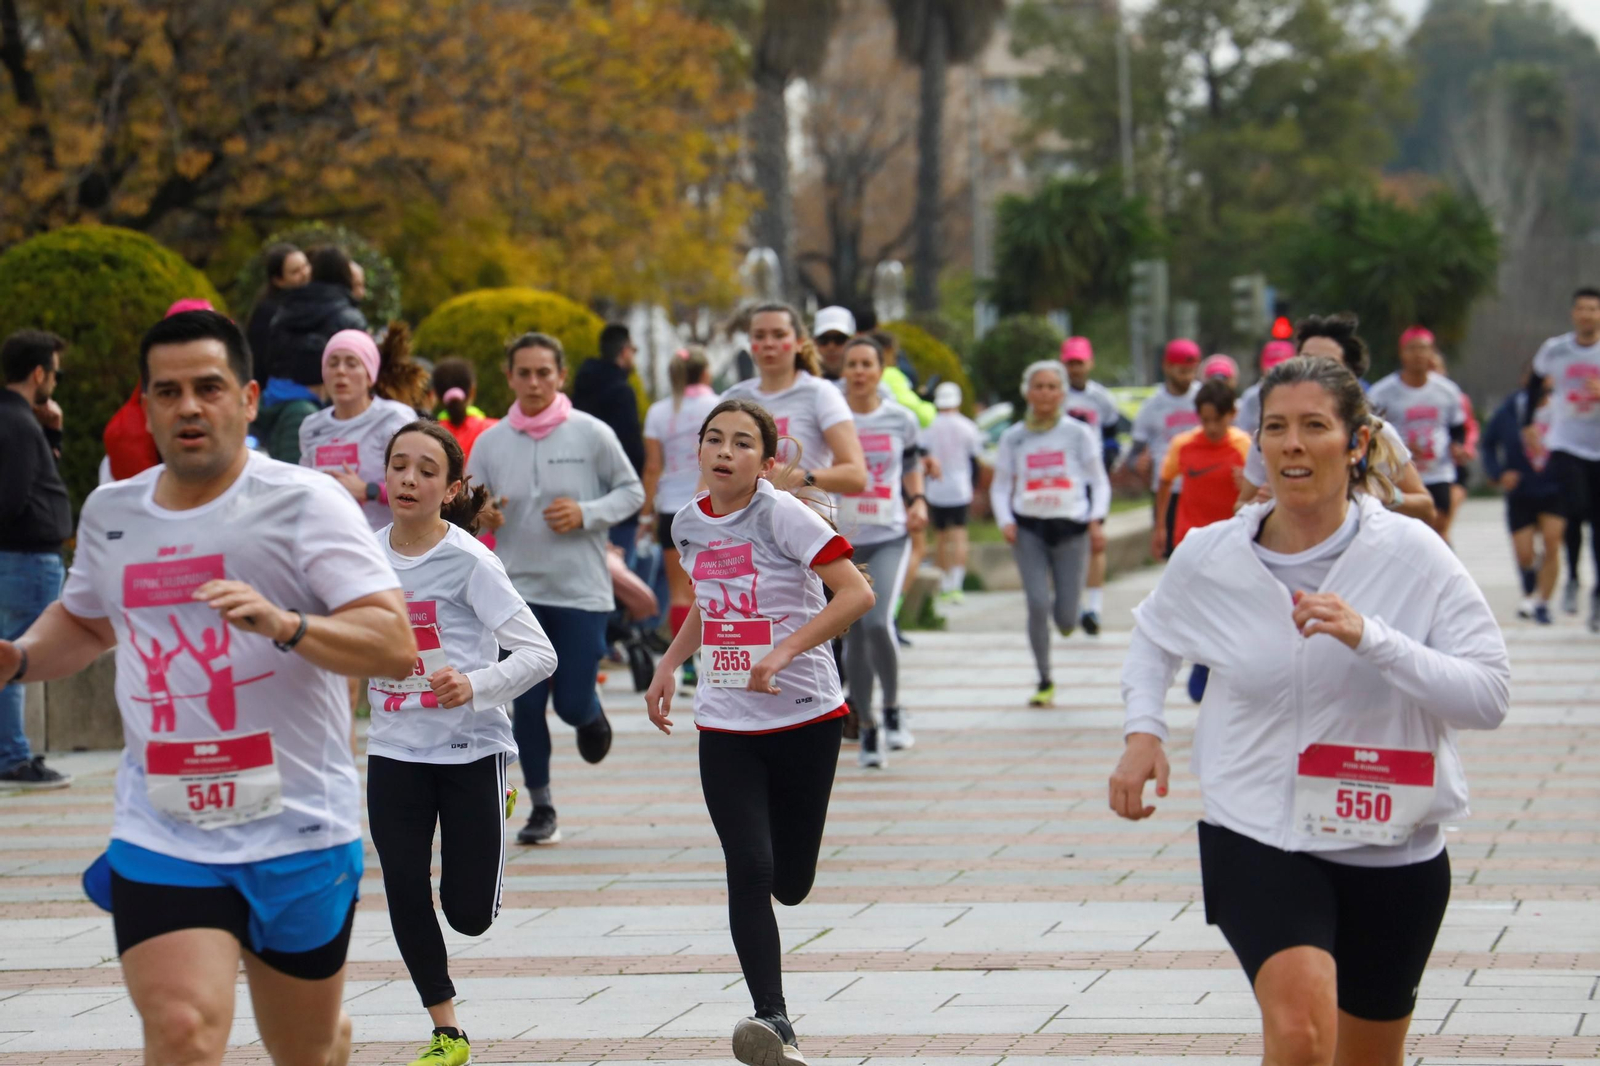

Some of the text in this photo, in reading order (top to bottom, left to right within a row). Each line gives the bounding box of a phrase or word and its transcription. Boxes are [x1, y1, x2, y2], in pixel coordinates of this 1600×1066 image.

[700, 561, 718, 569] PINK
[712, 650, 751, 671] 2553
[187, 782, 235, 811] 547
[1336, 789, 1392, 823] 550
